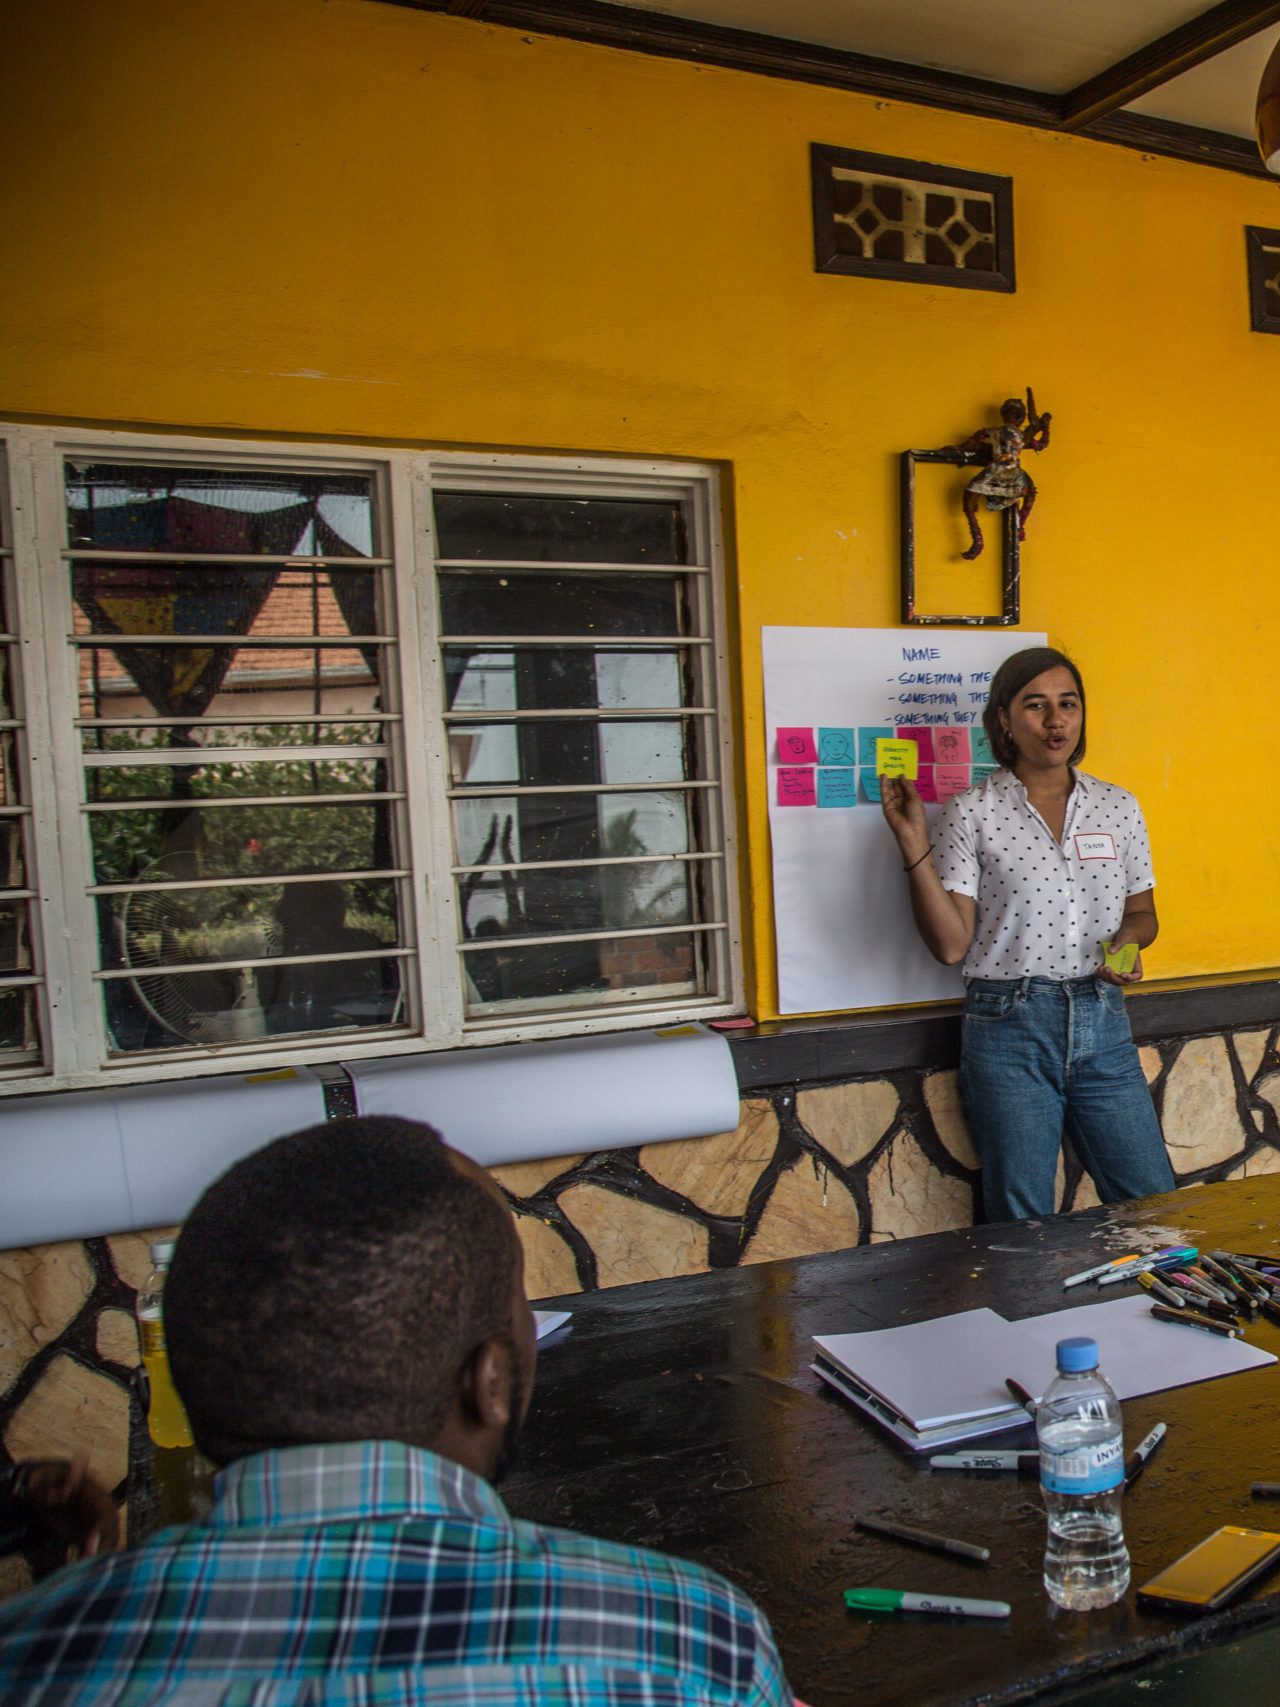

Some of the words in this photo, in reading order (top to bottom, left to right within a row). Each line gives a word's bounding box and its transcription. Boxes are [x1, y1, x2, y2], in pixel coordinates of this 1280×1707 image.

[902, 647, 941, 661] NAME
[898, 672, 963, 686] SOMETHING
[898, 692, 958, 706] SOMETHING
[893, 711, 949, 726] SOMETHING
[953, 711, 977, 724] THEY
